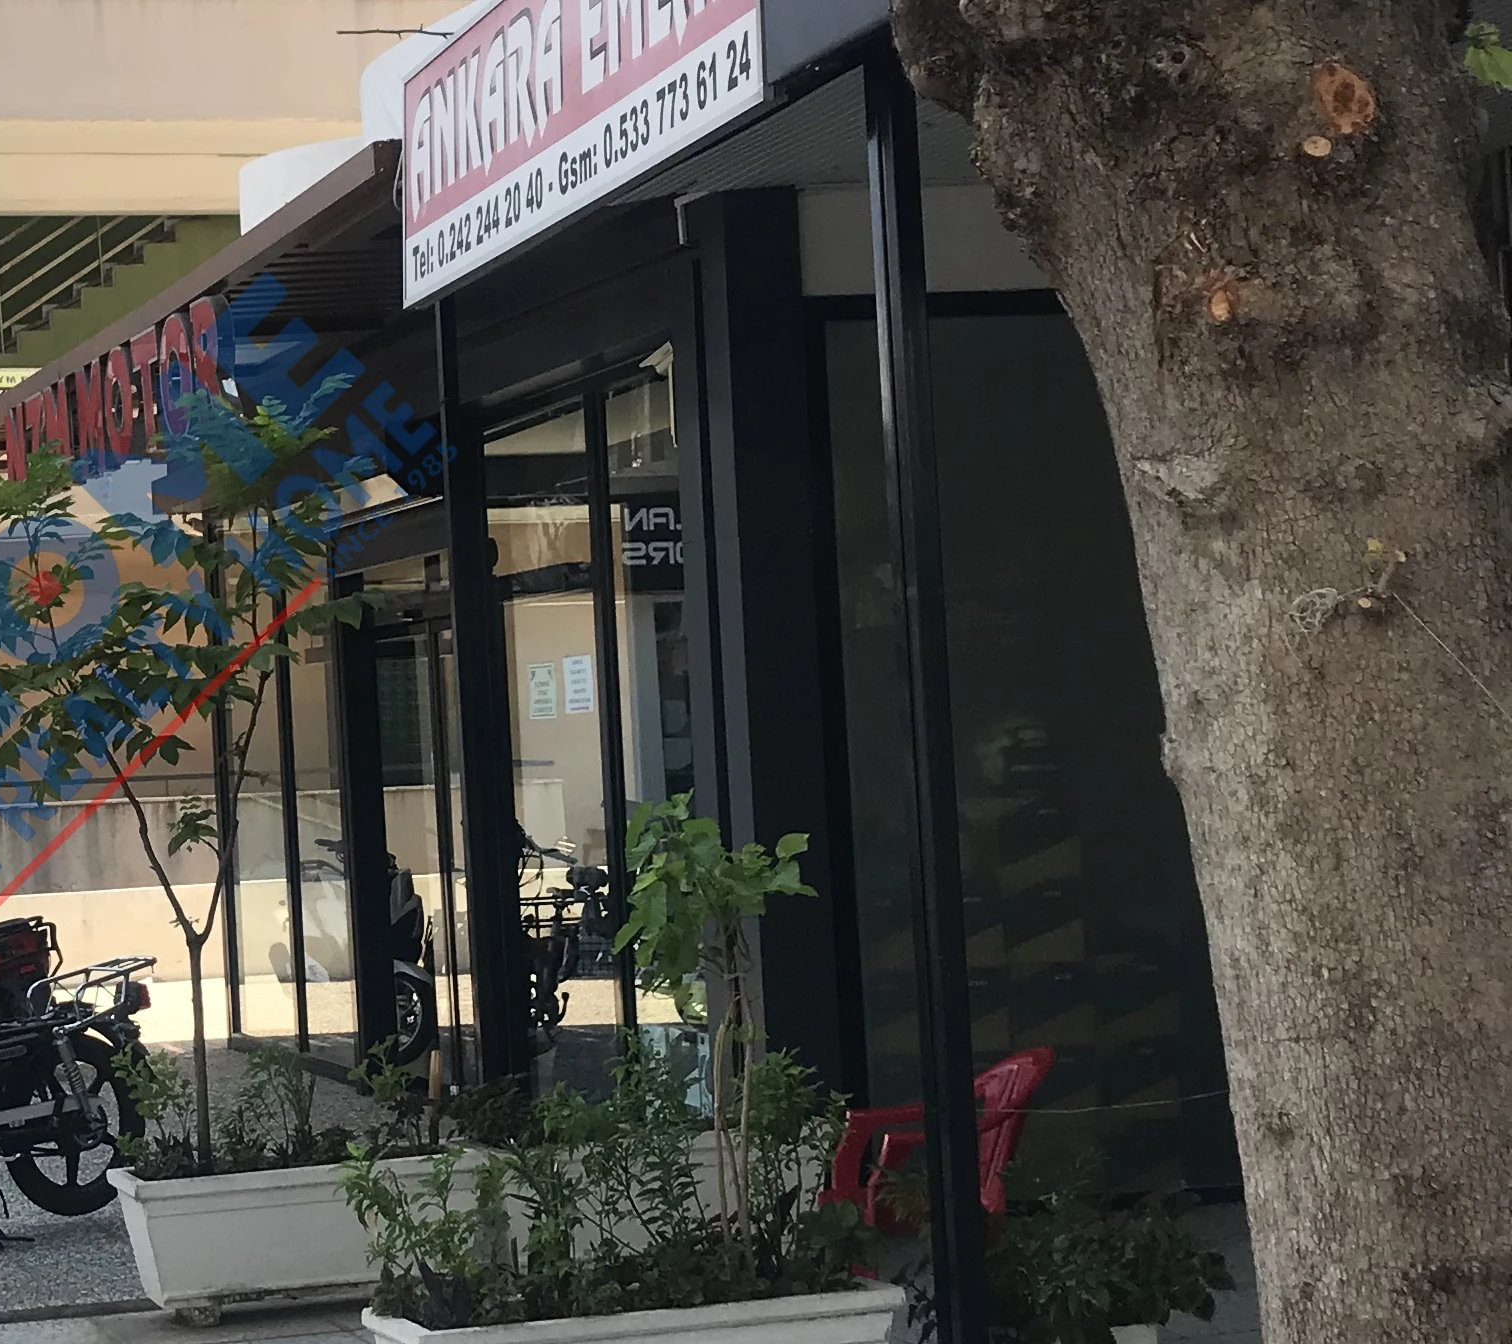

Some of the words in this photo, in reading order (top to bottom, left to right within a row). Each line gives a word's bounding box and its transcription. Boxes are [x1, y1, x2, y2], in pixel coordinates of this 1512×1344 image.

[412, 244, 434, 282] Tel:
[438, 213, 472, 267] 0.242
[476, 195, 500, 244] 244
[505, 183, 521, 229] 20
[526, 167, 544, 214] 40
[558, 142, 598, 196] Gsm:
[603, 99, 650, 170] 0.533
[656, 72, 689, 136] 773
[696, 51, 718, 110] 61
[726, 30, 751, 92] 24
[5, 378, 73, 482] NZM
[75, 296, 230, 476] MOTOR
